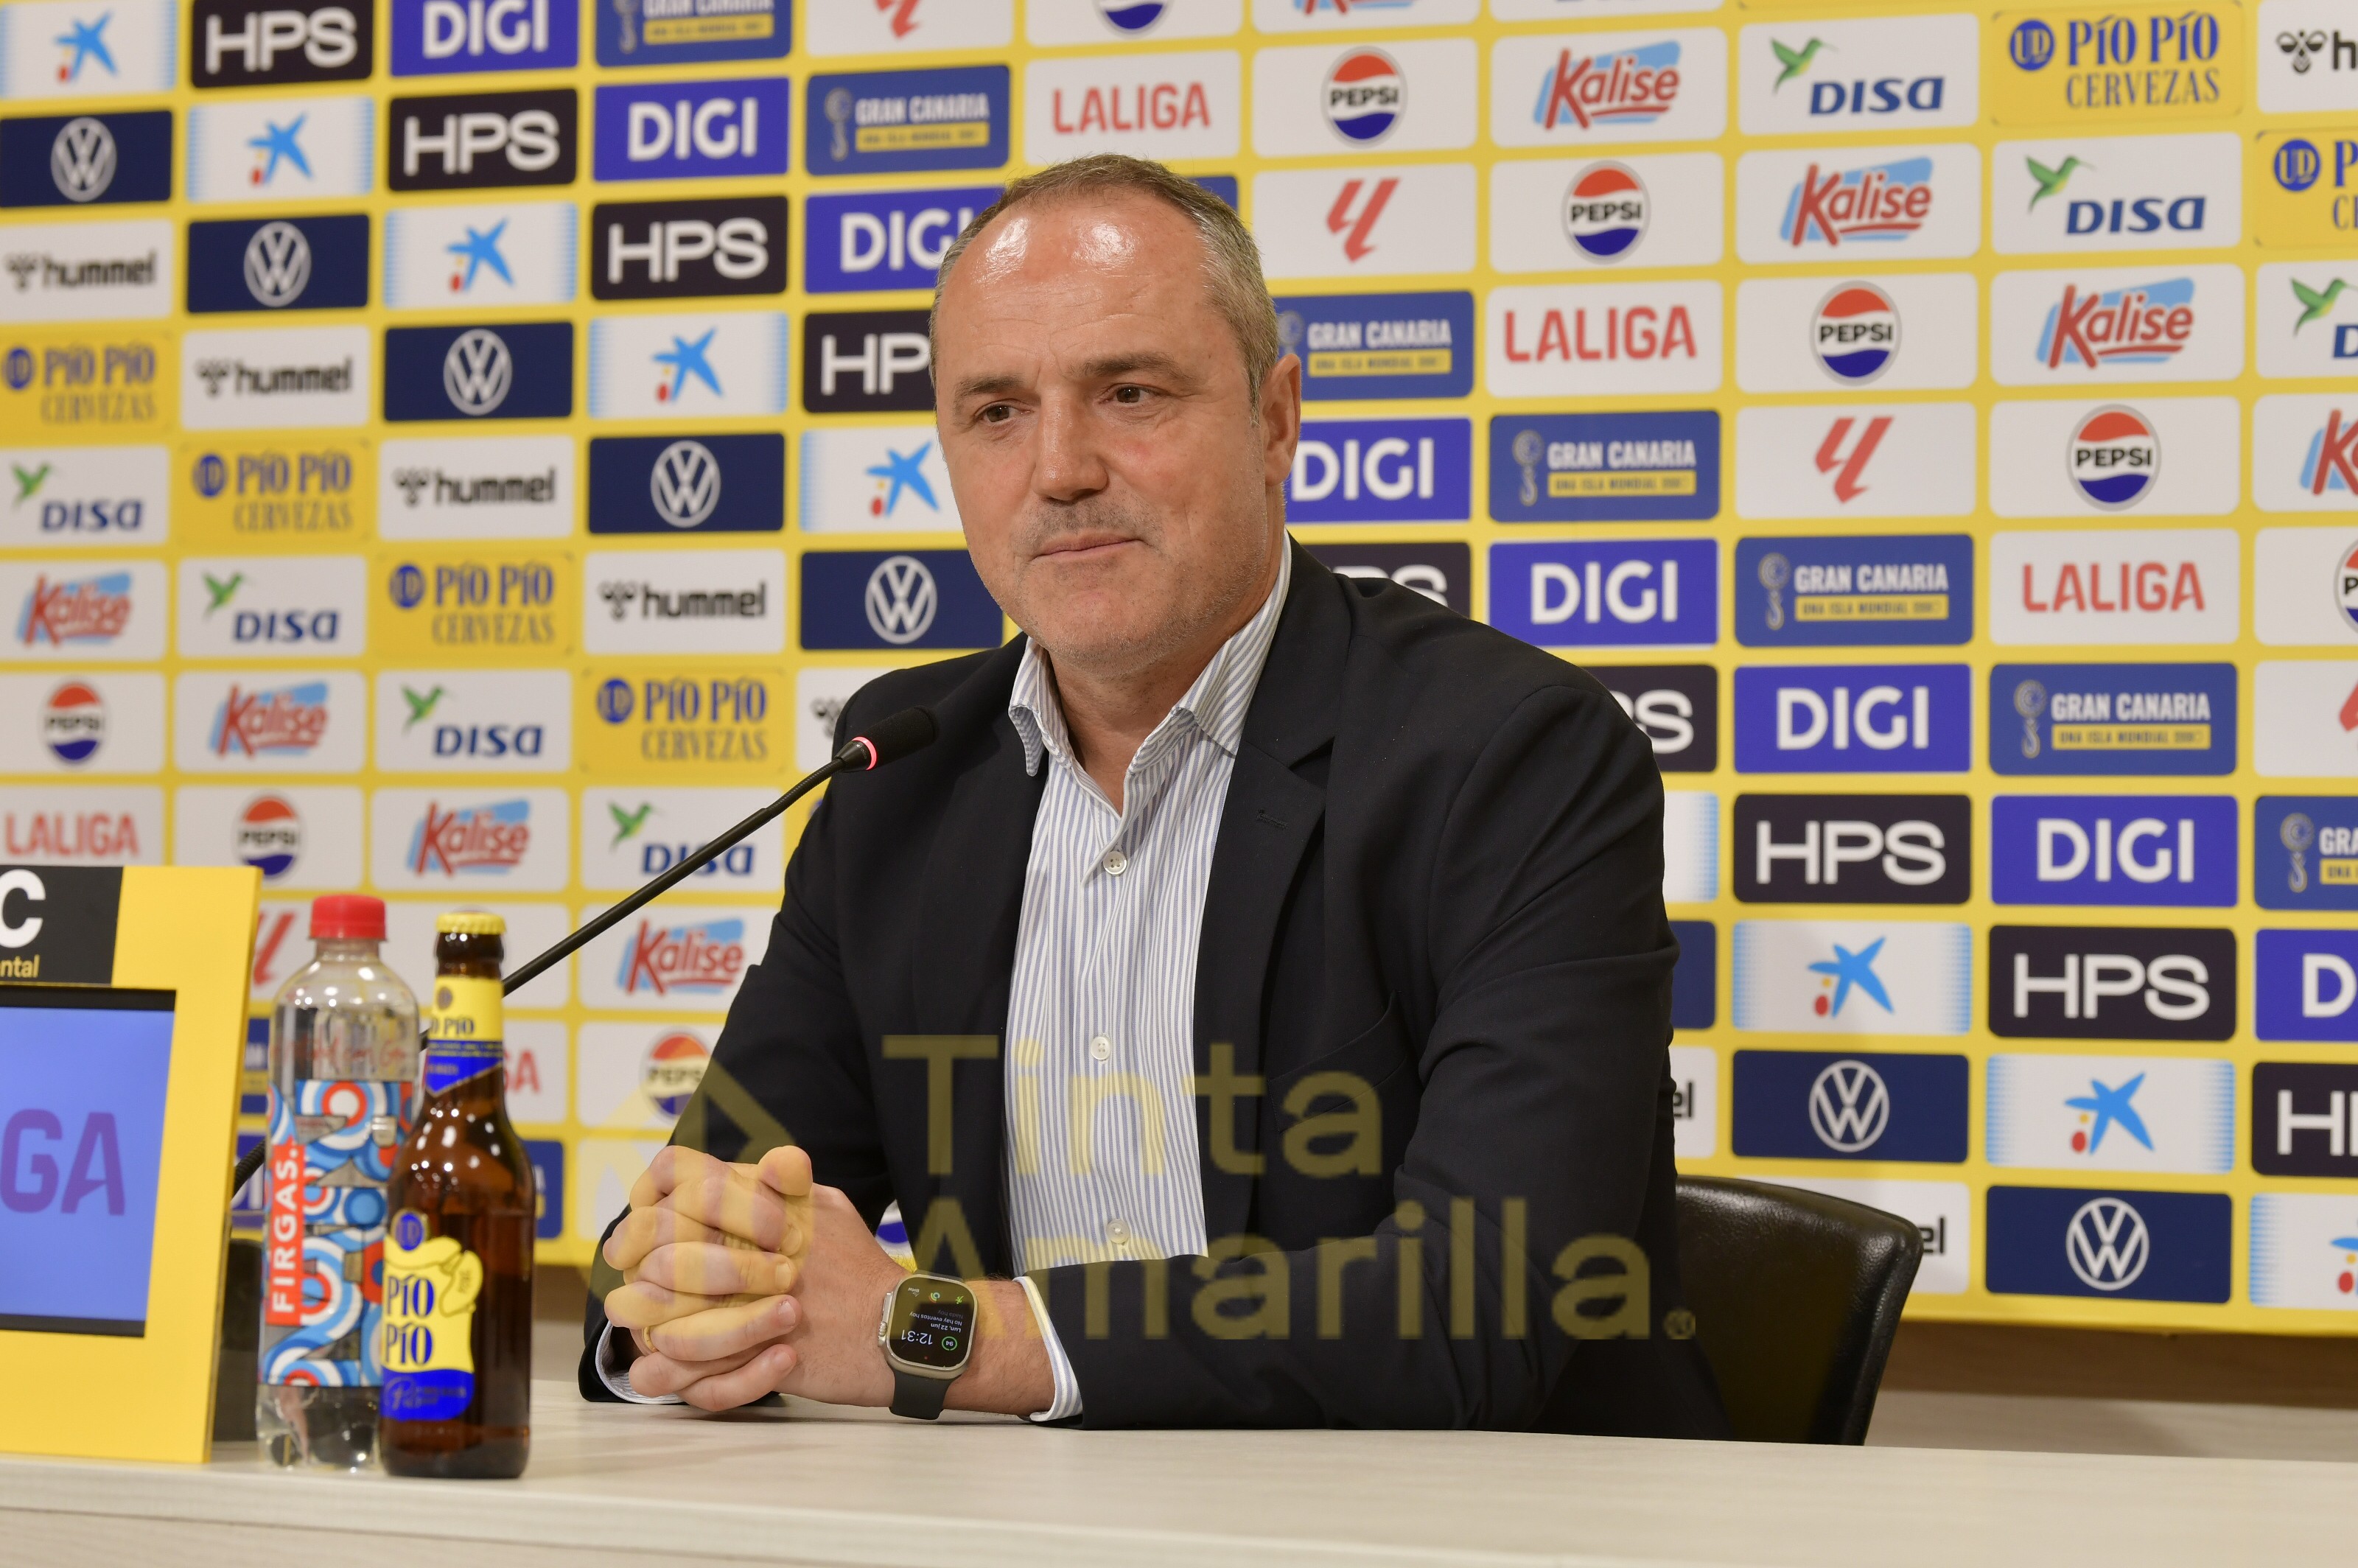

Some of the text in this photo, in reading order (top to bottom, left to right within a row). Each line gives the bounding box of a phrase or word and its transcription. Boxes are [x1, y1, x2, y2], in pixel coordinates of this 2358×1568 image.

[206, 8, 357, 74] HPS
[423, 0, 548, 58] DIGI
[856, 94, 990, 125] GRAN CANARIA
[1053, 82, 1211, 135] LALIGA
[1330, 86, 1399, 108] PEPSI
[1544, 48, 1680, 130] Kalise
[2066, 68, 2220, 108] CERVEZAS
[405, 110, 559, 176] HPS
[628, 98, 758, 161] DIGI
[1570, 202, 1642, 223] PEPSI
[1791, 164, 1932, 247] Kalise
[42, 251, 157, 286] hummel
[608, 219, 769, 282] HPS
[1308, 318, 1452, 350] GRAN CANARIA
[1505, 305, 1697, 362] LALIGA
[1819, 323, 1893, 343] PEPSI
[2049, 284, 2194, 369] Kalise
[235, 357, 351, 394] hummel
[820, 333, 931, 395] HP
[1292, 437, 1433, 501] DIGI
[1548, 439, 1696, 469] GRAN CANARIA
[2077, 447, 2152, 467] PEPSI
[436, 467, 555, 505] hummel
[643, 581, 766, 618] hummel
[1531, 561, 1678, 624] DIGI
[1795, 564, 1948, 593] GRAN CANARIA
[2022, 561, 2205, 612] LALIGA
[432, 610, 556, 646] CERVEZAS
[218, 682, 327, 760] Kalise
[1777, 685, 1929, 749] DIGI
[2051, 693, 2211, 721] GRAN CANARIA
[642, 729, 768, 762] CERVEZAS
[5, 810, 139, 858] LALIGA
[416, 801, 531, 878] Kalise
[1757, 821, 1946, 884] HPS
[2037, 818, 2194, 883] DIGI
[2319, 826, 2358, 856] GRA
[627, 918, 744, 995] Kalise
[2013, 953, 2210, 1021] HPS
[648, 1068, 703, 1085] PEPS
[901, 1329, 933, 1345] 12:31
[909, 1311, 920, 1319] hoy
[921, 1314, 942, 1323] eventos
